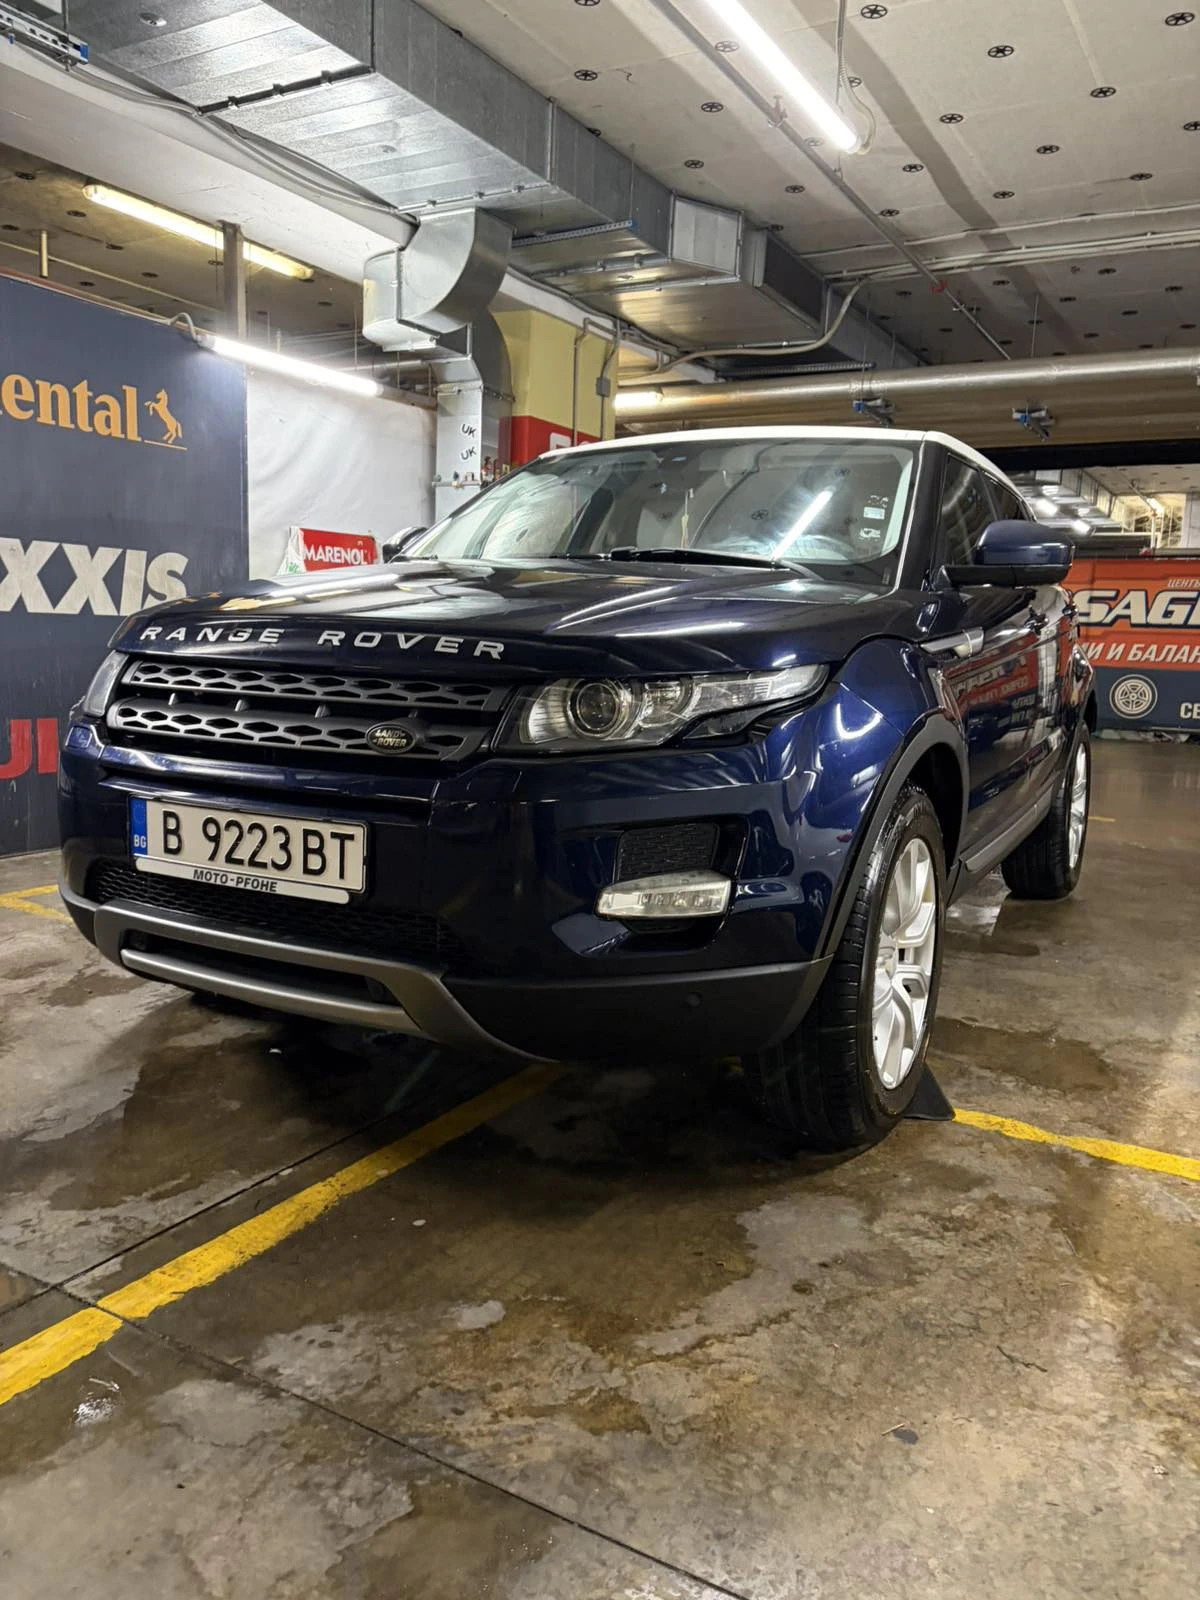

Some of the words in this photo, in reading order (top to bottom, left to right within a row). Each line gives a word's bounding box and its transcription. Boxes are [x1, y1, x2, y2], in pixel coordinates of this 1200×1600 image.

[0, 373, 141, 442] ental
[303, 544, 367, 565] MARENOL
[140, 626, 285, 645] RANGE
[317, 630, 505, 660] ROVER
[1107, 642, 1126, 660] И
[375, 729, 401, 737] LAND
[377, 738, 407, 746] ROVER
[133, 834, 147, 848] BG
[162, 810, 183, 855] B
